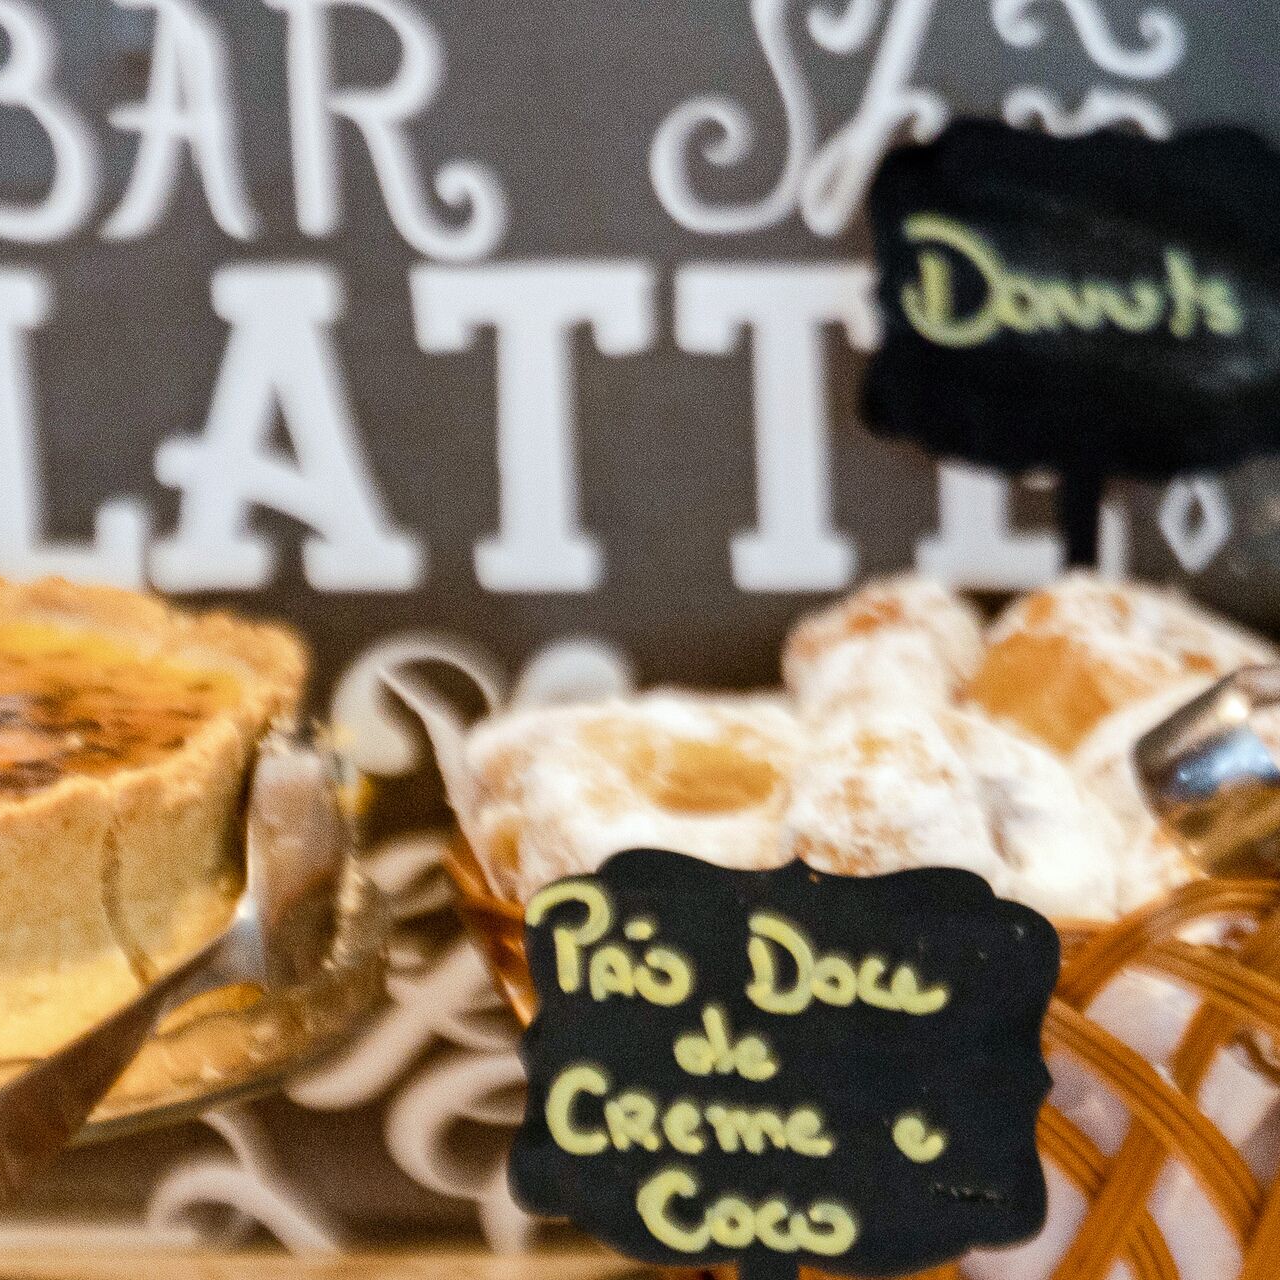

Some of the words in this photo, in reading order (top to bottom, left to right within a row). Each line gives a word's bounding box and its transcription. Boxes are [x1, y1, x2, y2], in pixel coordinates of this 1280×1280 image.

[902, 213, 1244, 348] Donuts
[745, 912, 948, 1015] Doce
[673, 1005, 778, 1081] de
[545, 1065, 835, 1157] Creme
[892, 1113, 946, 1162] e
[635, 1168, 859, 1255] Coco
